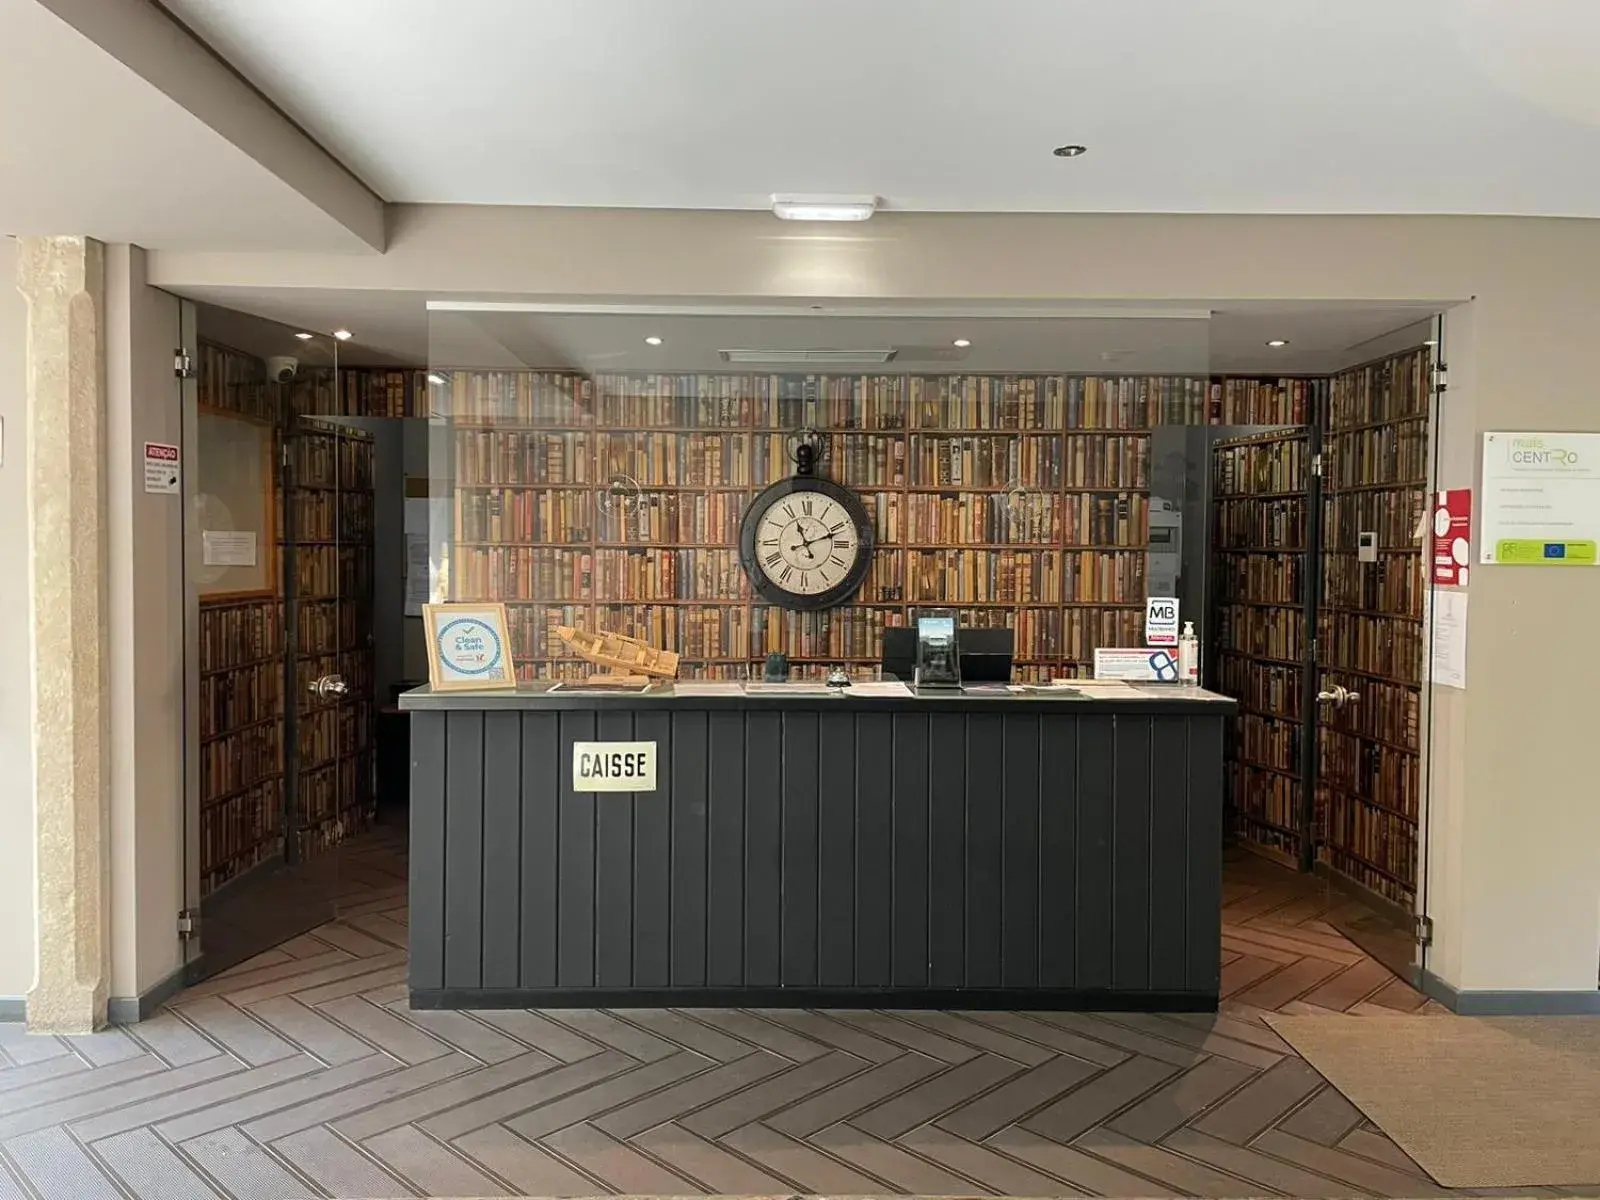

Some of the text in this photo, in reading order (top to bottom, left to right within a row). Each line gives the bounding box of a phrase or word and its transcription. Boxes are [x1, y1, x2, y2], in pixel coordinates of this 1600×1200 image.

[1513, 448, 1578, 465] CENTRO
[1149, 606, 1175, 620] MB
[455, 636, 482, 645] Clean
[580, 753, 646, 778] CAISSE
